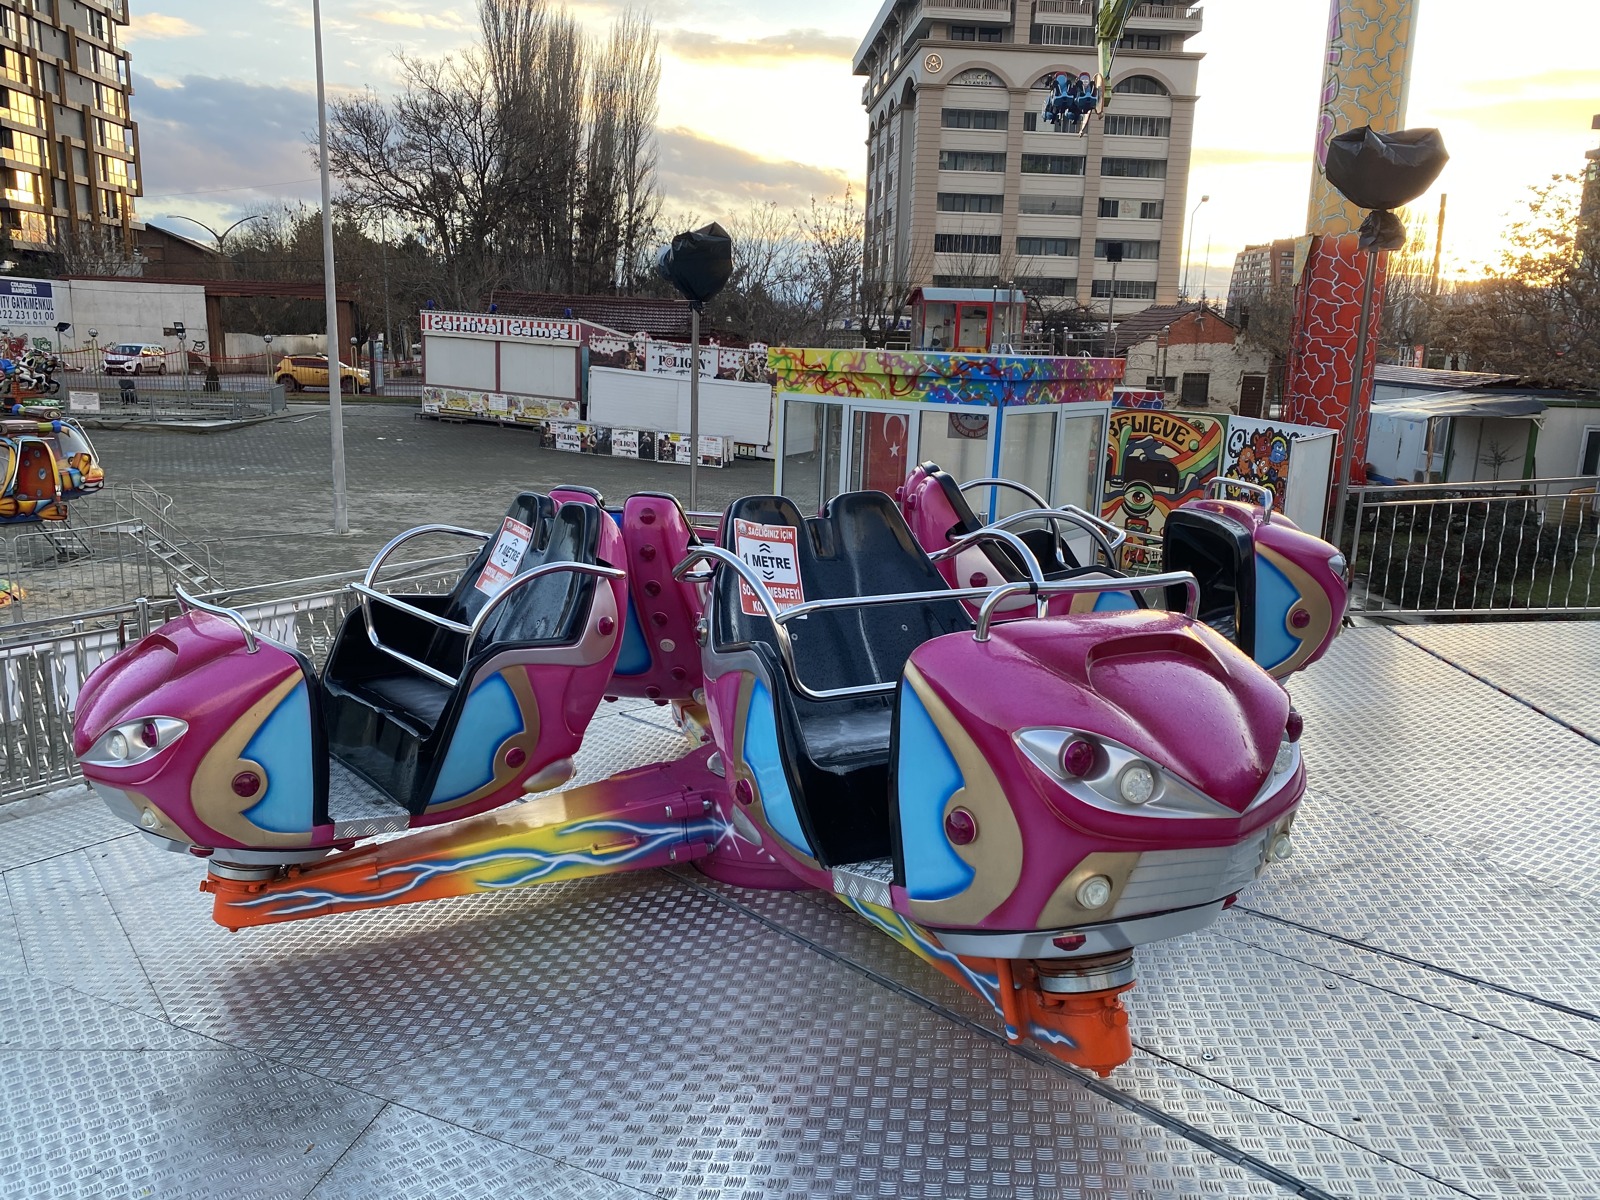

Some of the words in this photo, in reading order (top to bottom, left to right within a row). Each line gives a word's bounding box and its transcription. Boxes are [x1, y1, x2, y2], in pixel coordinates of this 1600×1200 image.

[16, 311, 30, 320] 231
[33, 311, 42, 320] 01
[45, 312, 55, 320] 00
[431, 317, 502, 334] Carnival
[509, 323, 570, 339] Games
[659, 355, 706, 369] POLIGN
[1109, 415, 1190, 446] BELIEVE
[780, 531, 793, 541] İÇİN
[502, 545, 521, 562] METRE
[743, 552, 749, 565] 1
[752, 554, 791, 570] METRE
